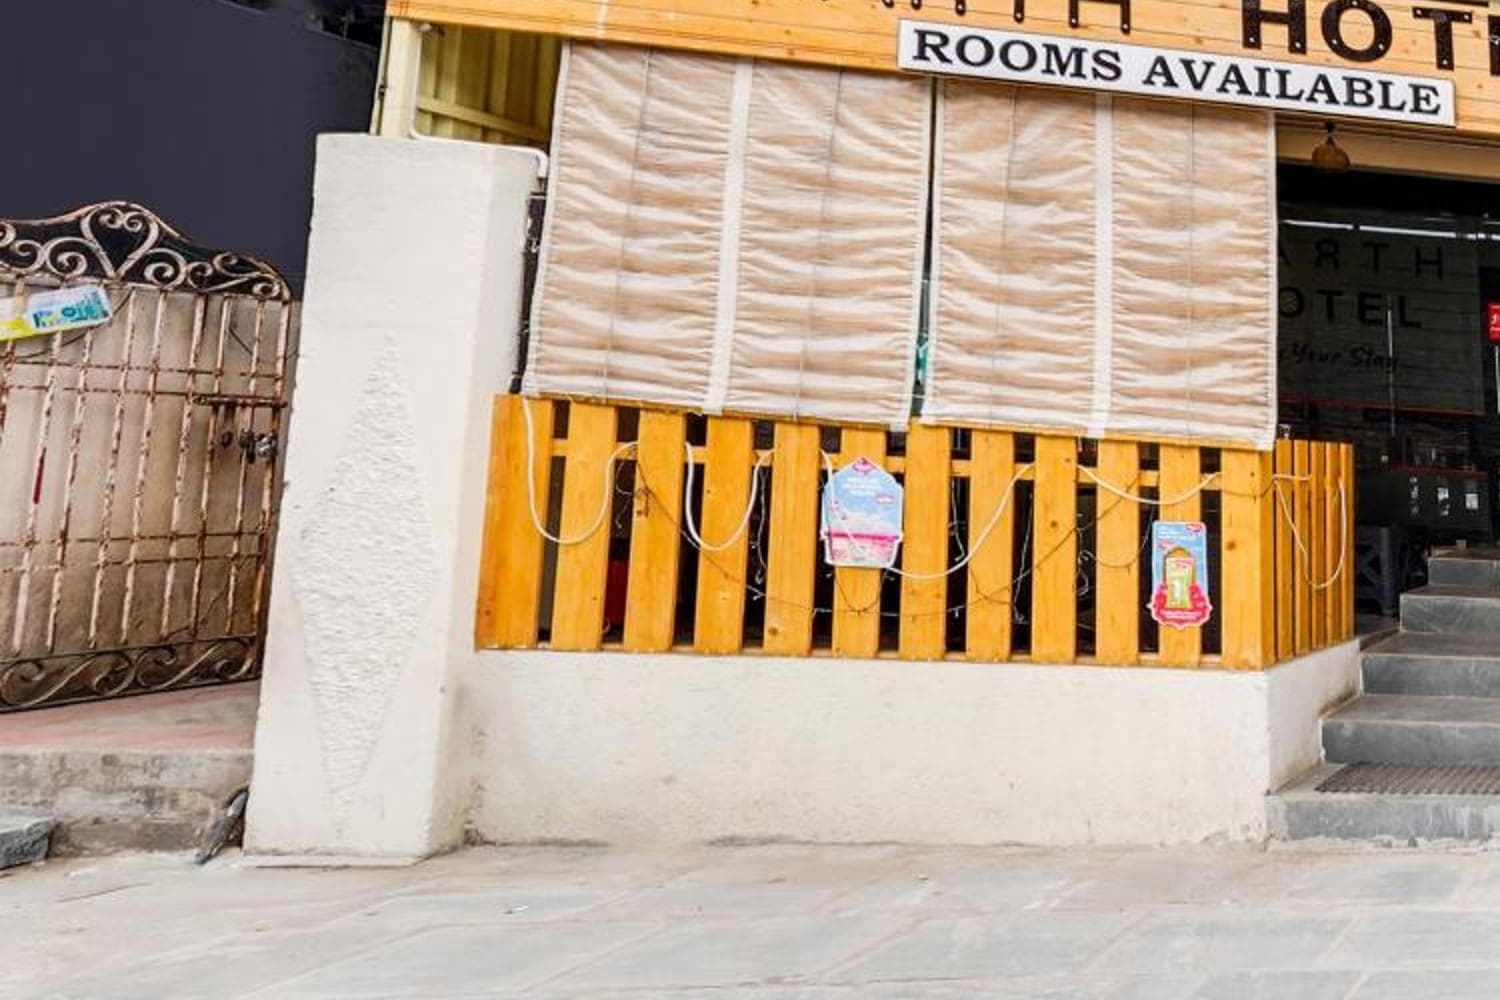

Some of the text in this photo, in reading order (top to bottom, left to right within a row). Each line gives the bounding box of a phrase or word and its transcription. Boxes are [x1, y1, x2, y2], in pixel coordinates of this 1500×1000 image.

[912, 28, 1442, 117] ROOMS AVAILABLE
[1279, 286, 1422, 329] OTEL
